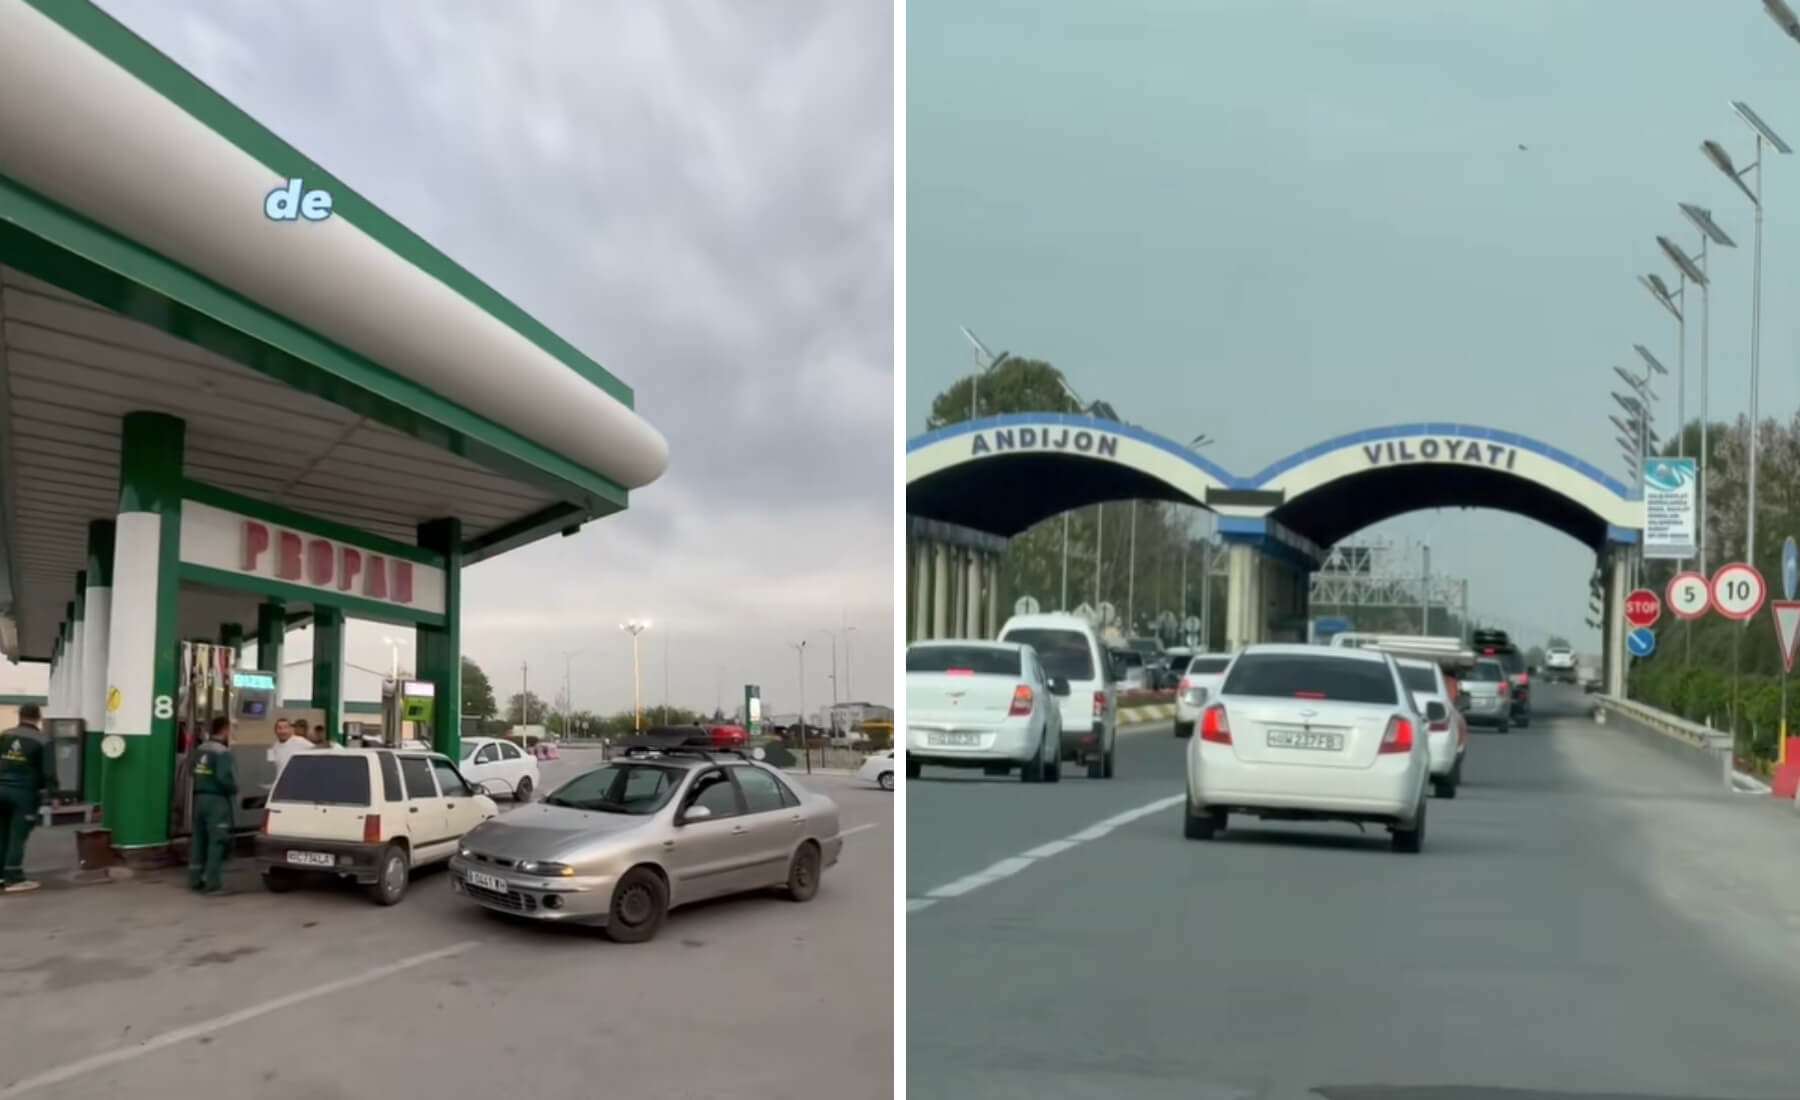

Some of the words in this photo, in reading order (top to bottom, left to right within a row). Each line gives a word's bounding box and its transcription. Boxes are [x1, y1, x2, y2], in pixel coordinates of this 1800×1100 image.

[971, 428, 1118, 457] ANDIJON
[1363, 438, 1516, 470] VILOYATI
[241, 520, 413, 604] PROPAN
[1683, 586, 1696, 603] 5
[1726, 580, 1750, 601] 10
[1626, 600, 1658, 614] STOP
[155, 694, 174, 719] 8
